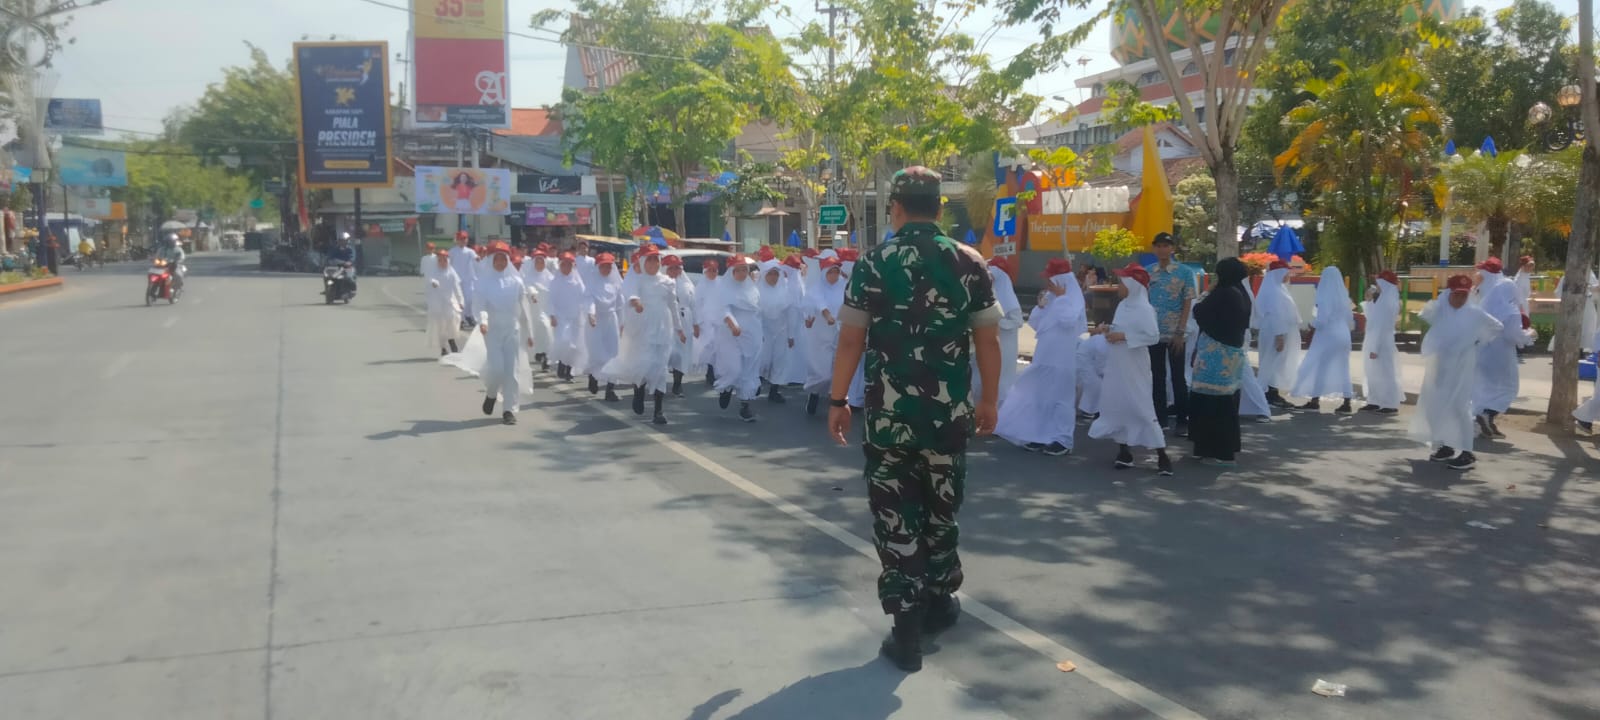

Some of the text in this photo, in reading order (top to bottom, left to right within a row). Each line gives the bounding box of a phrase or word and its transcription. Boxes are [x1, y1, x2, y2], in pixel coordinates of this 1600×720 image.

[332, 117, 359, 129] PIALA
[317, 130, 377, 147] PRESIDEN
[998, 203, 1015, 231] P
